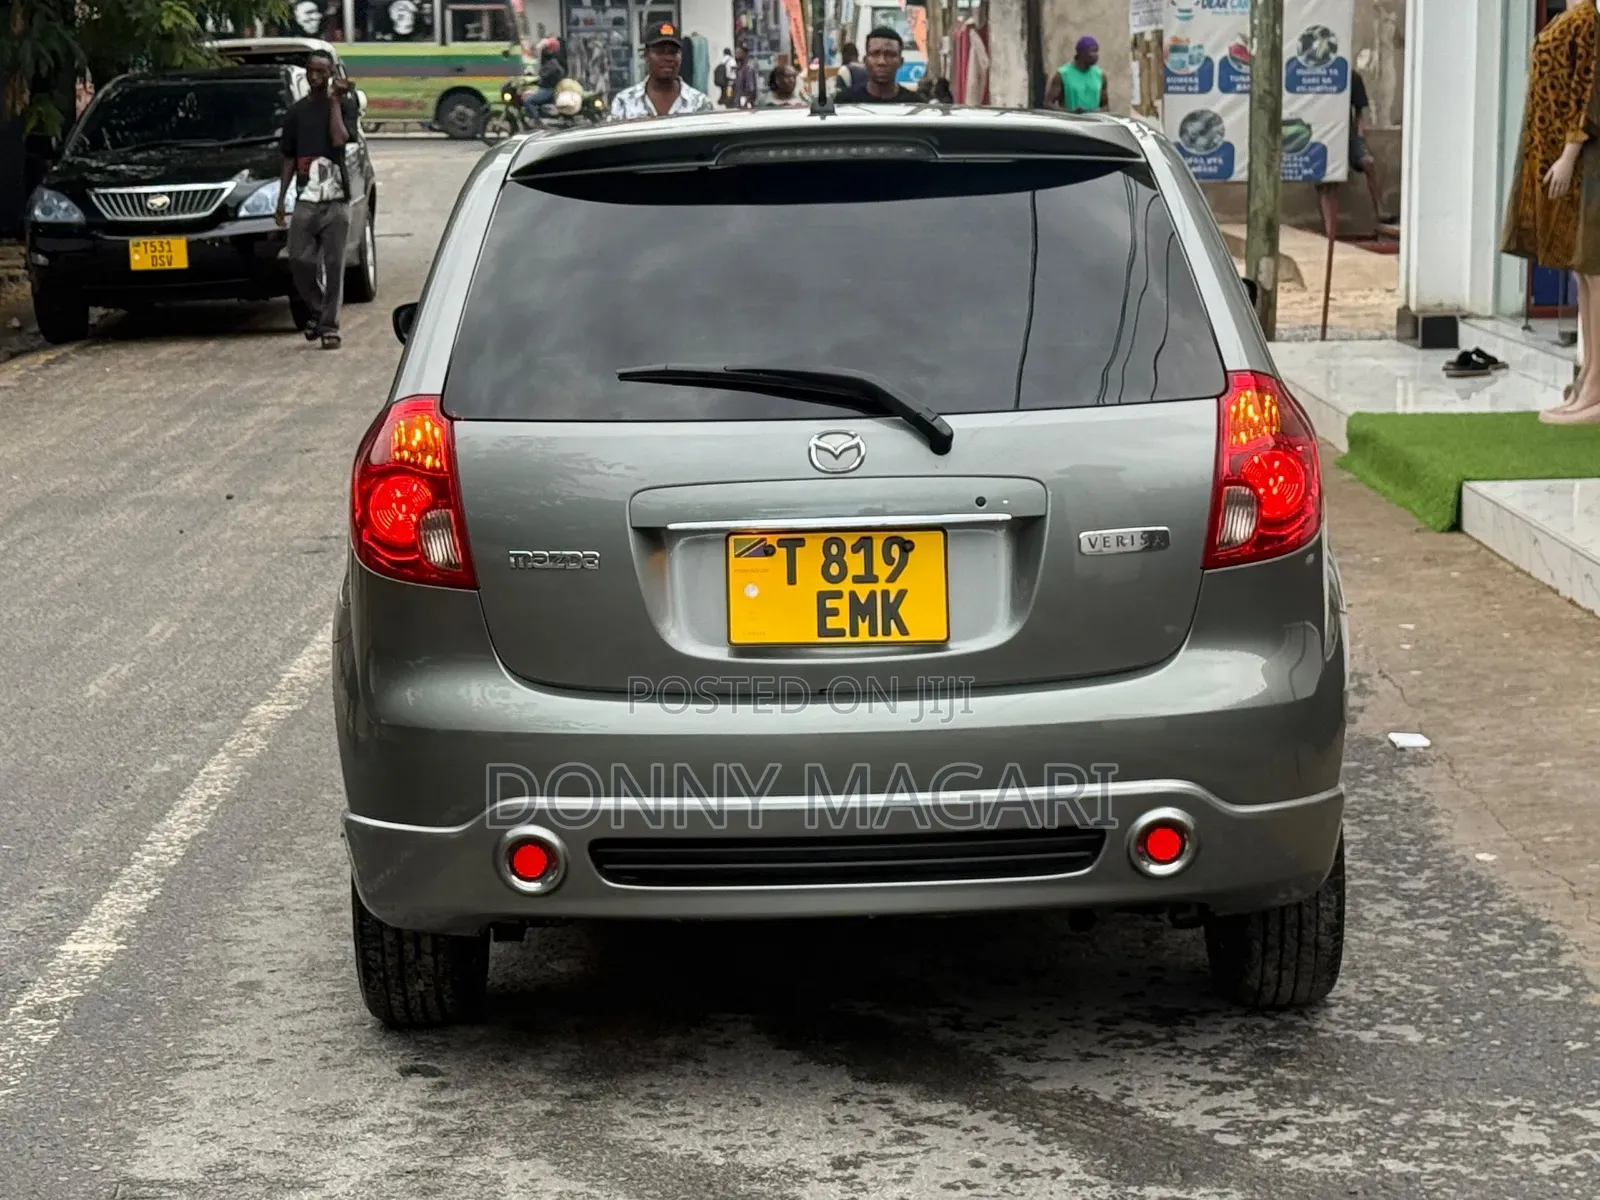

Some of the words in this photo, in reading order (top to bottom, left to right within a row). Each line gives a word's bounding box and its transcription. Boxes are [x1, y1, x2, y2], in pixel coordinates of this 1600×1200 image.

[142, 240, 173, 254] T531
[151, 254, 173, 267] DSV
[777, 537, 806, 586] T
[821, 535, 912, 584] 819
[816, 588, 910, 638] EMK
